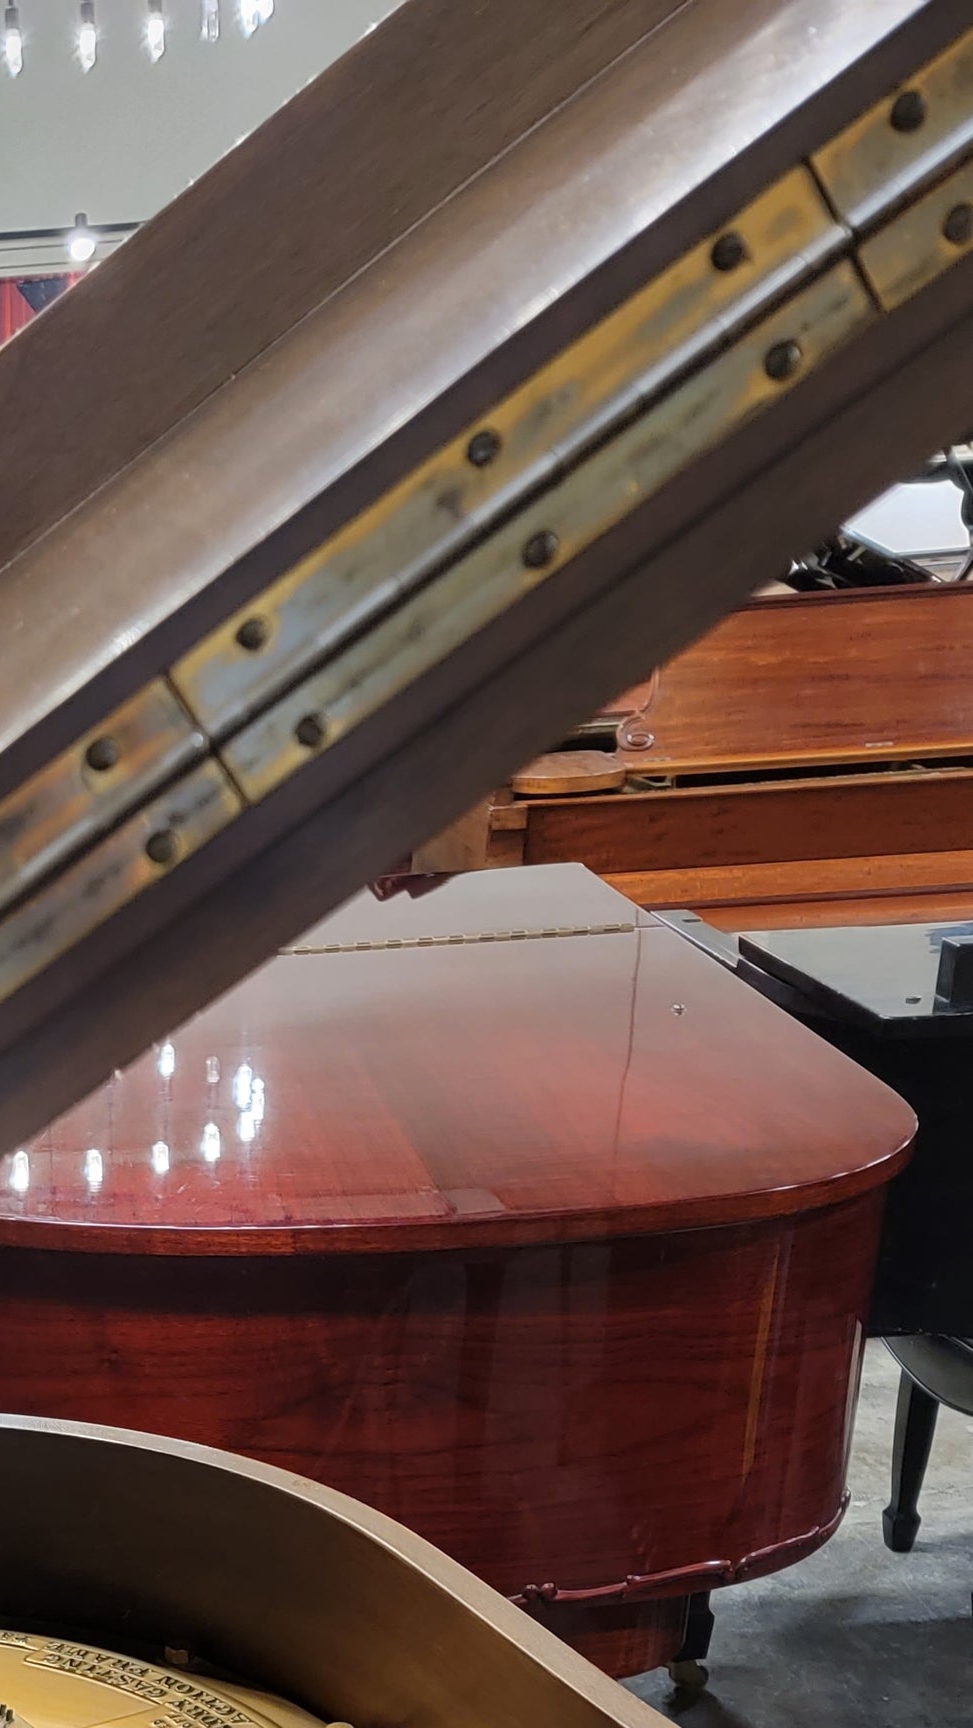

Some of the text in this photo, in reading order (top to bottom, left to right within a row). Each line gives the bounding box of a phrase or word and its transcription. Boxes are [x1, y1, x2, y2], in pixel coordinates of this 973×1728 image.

[43, 1652, 168, 1698] CASTING
[44, 1641, 153, 1678] FRAME
[155, 1675, 255, 1725] ACTION
